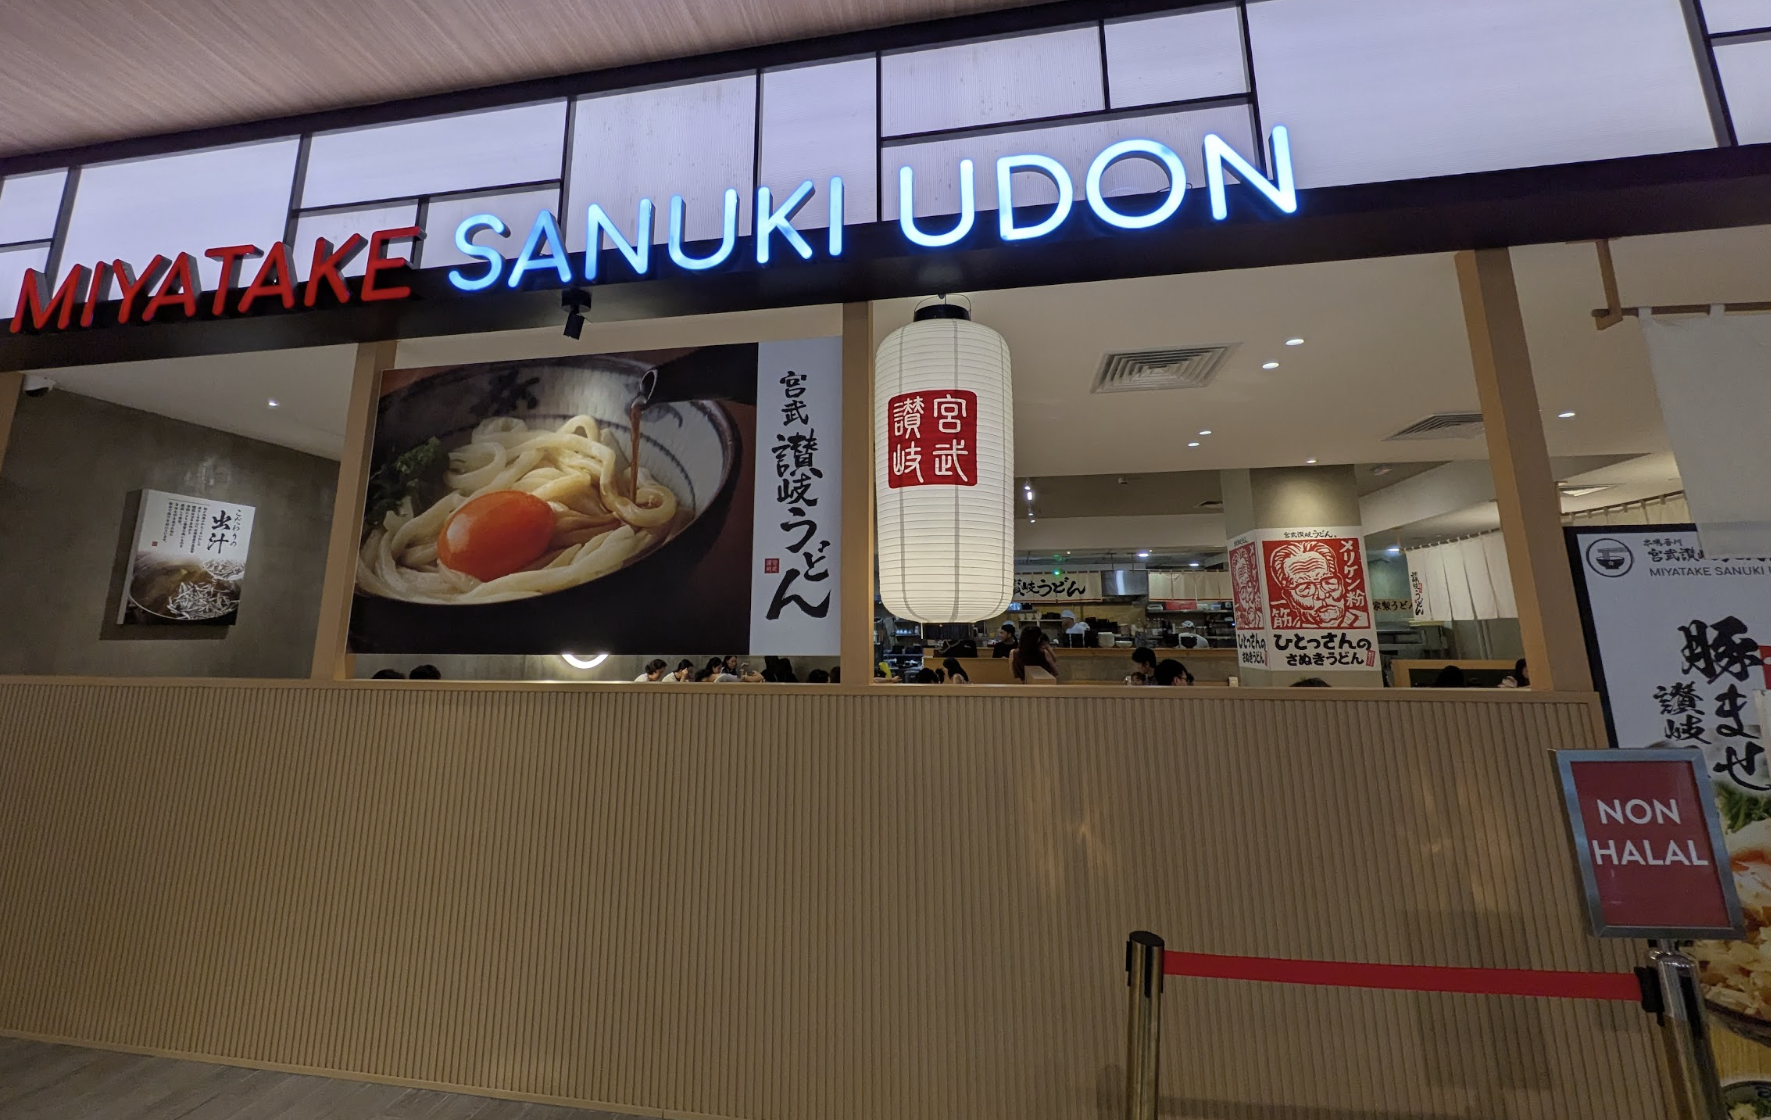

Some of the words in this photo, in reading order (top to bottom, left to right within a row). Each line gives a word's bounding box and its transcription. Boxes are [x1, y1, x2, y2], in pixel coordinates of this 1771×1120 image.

[10, 225, 422, 334] MIYATAKE
[448, 175, 843, 292] SANUKI
[899, 125, 1298, 247] UDON
[893, 396, 925, 483] 讃岐
[932, 393, 969, 482] 宮武
[207, 510, 232, 554] 出汁
[1341, 540, 1365, 607] メリケン粉
[1649, 566, 1712, 577] MIYATAKE
[1715, 566, 1765, 576] SANUKI
[1286, 652, 1364, 666] さぬきうどん
[1597, 799, 1681, 825] NON
[1592, 840, 1709, 866] HALAL
